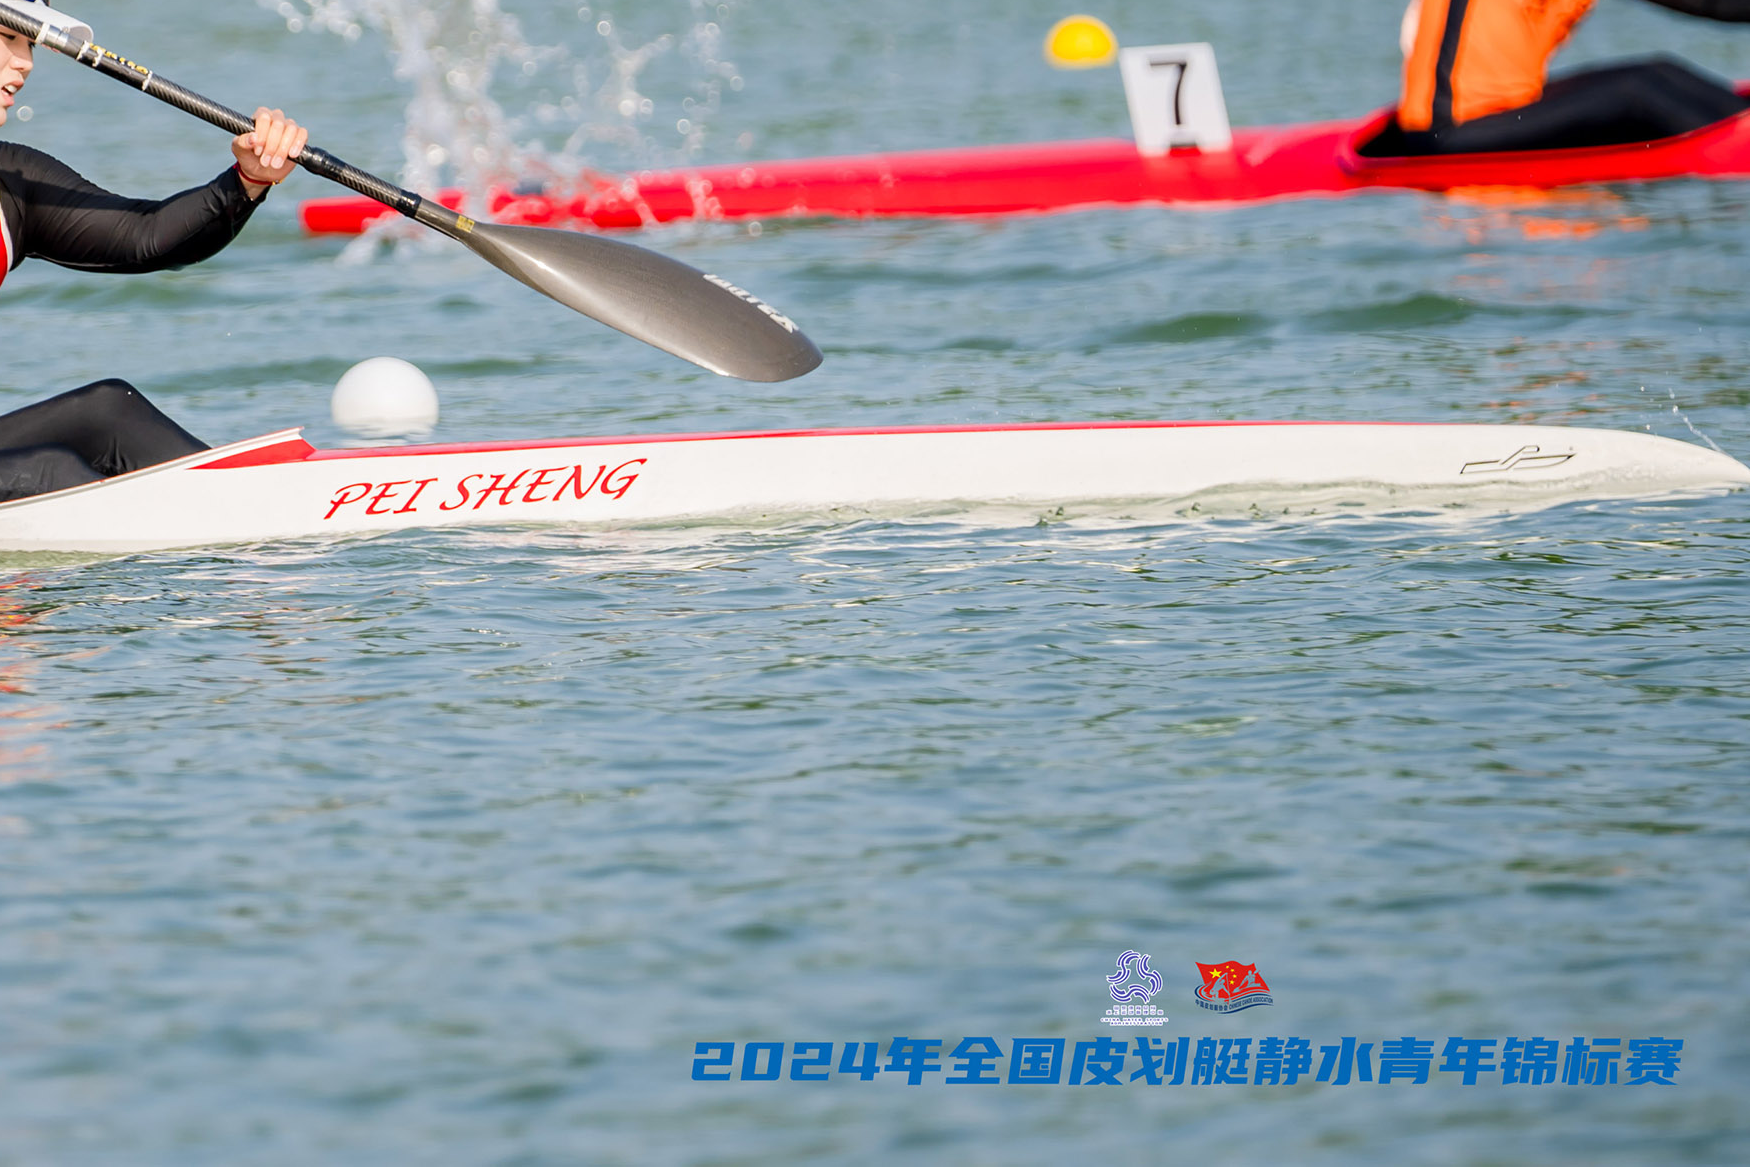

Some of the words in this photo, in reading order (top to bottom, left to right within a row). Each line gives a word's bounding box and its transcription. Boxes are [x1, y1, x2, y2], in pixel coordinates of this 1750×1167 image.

[1148, 61, 1188, 126] 7
[323, 478, 438, 520] PEI
[439, 458, 648, 511] SHENG
